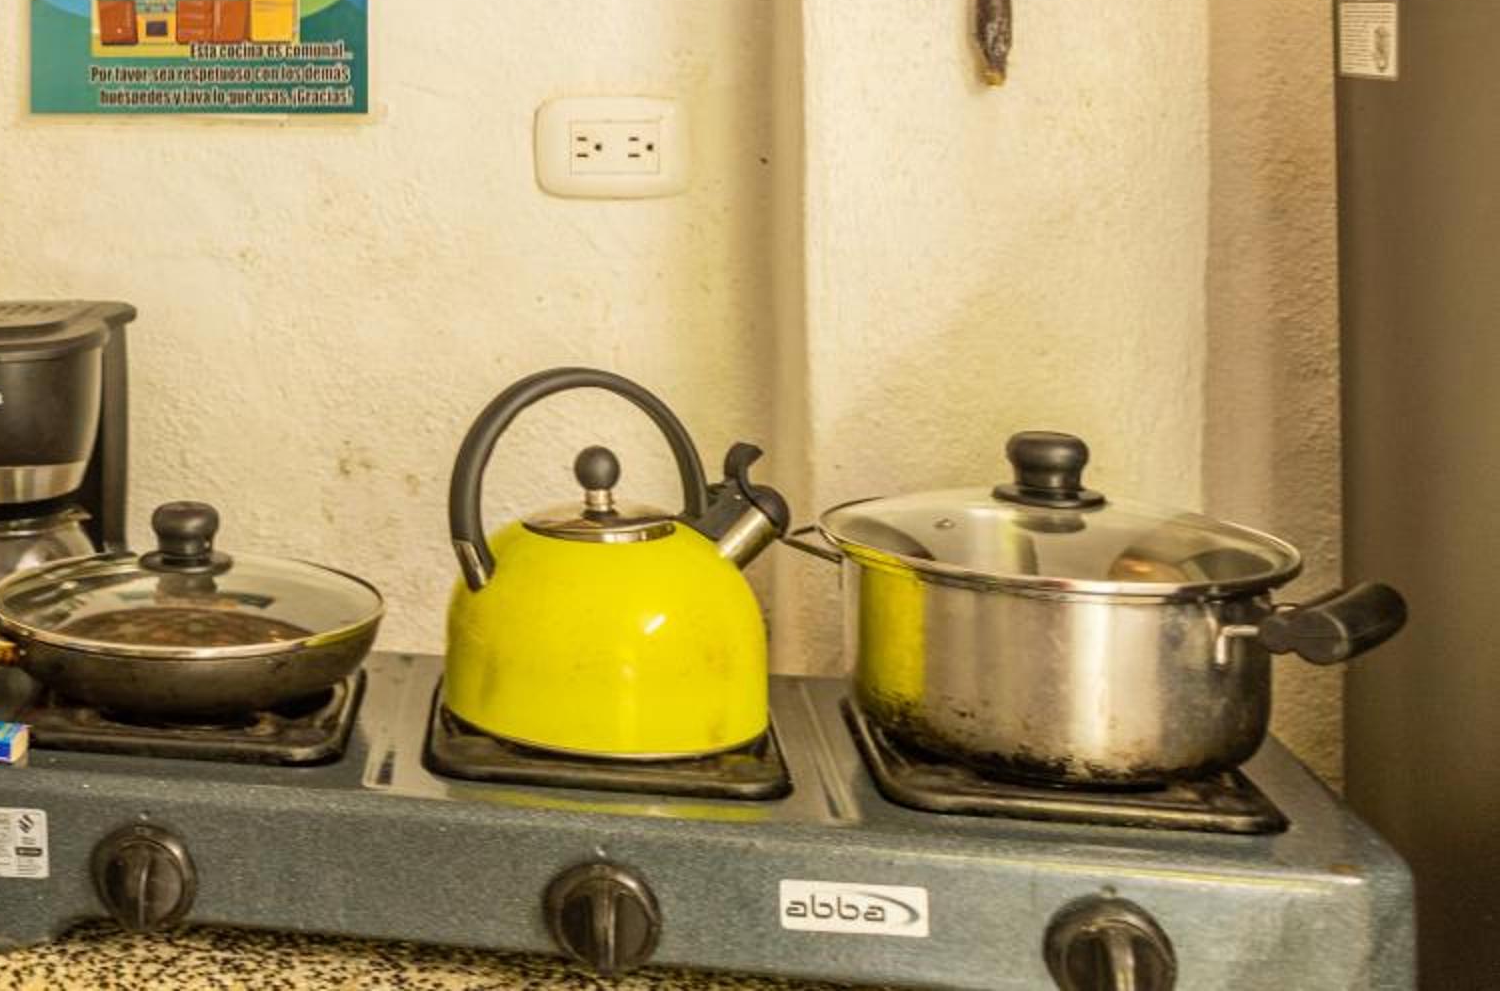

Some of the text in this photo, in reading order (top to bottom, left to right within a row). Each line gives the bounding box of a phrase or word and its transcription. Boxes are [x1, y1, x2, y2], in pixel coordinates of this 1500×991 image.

[190, 43, 217, 59] Esta
[219, 42, 263, 59] cocina
[267, 43, 281, 59] es
[91, 66, 112, 82] Por
[152, 67, 175, 82] sea
[178, 66, 251, 83] respetuoso
[254, 66, 280, 82] con
[281, 65, 302, 82] los
[172, 91, 181, 106] y
[183, 89, 211, 105] lava
[213, 89, 225, 104] lo
[786, 894, 885, 922] abba
